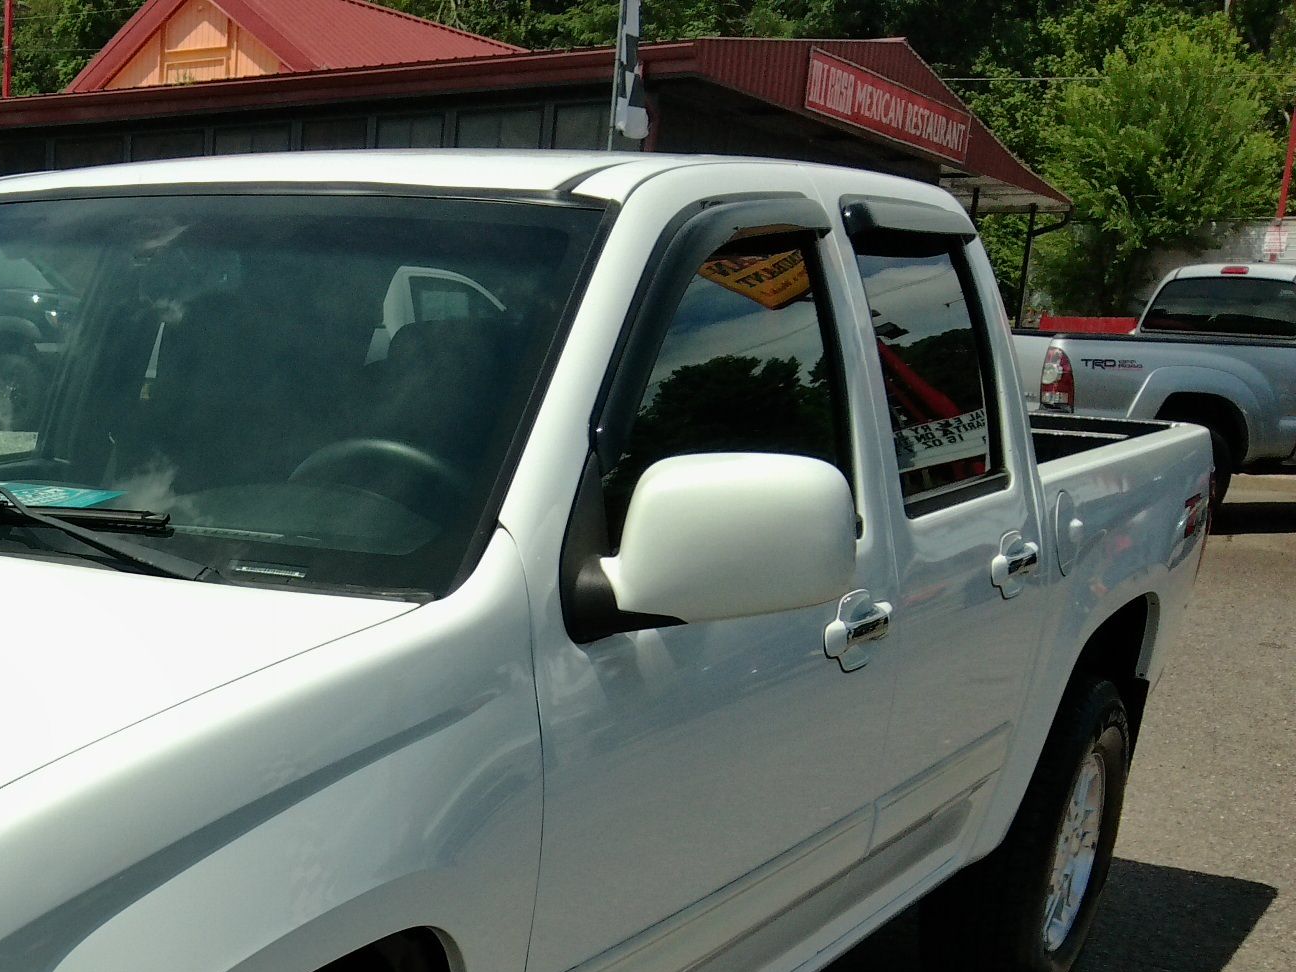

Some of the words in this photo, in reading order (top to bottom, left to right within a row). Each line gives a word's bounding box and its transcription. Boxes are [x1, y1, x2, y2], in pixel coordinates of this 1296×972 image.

[855, 81, 904, 130] MEXICAN
[905, 102, 966, 152] RESTAURANT
[1080, 358, 1116, 370] TRD
